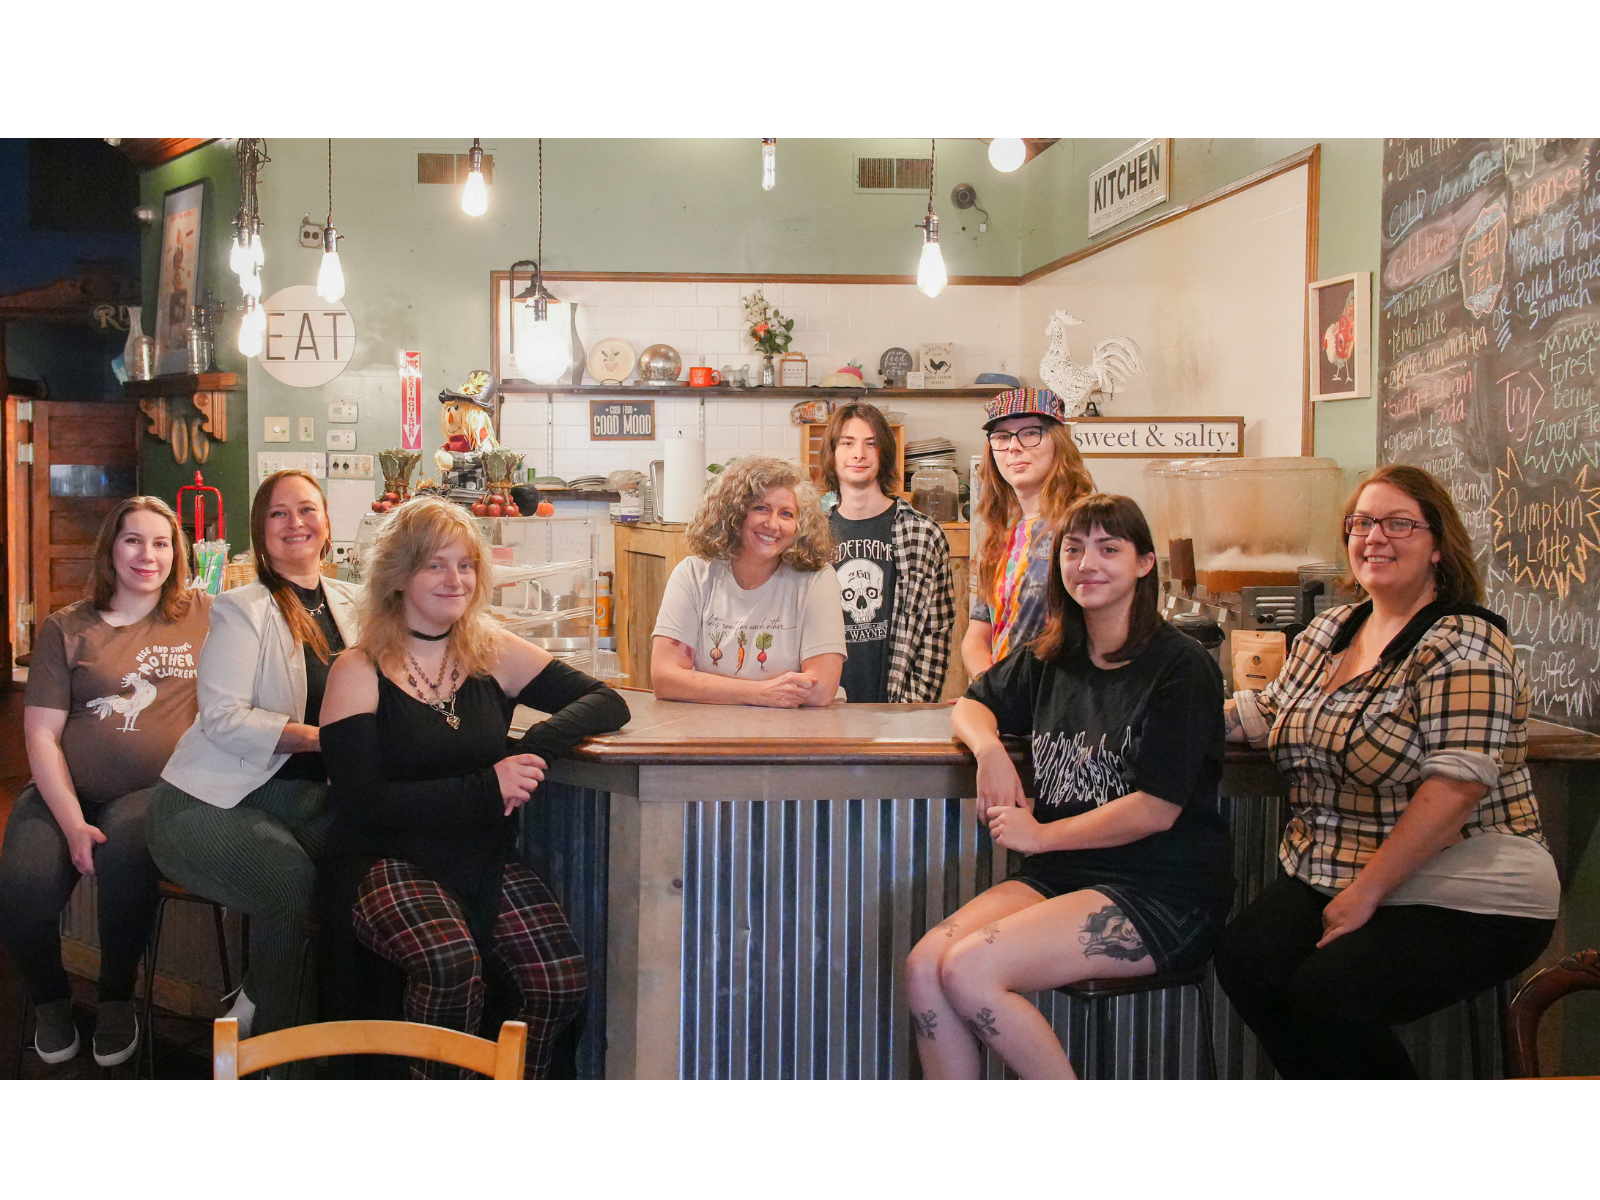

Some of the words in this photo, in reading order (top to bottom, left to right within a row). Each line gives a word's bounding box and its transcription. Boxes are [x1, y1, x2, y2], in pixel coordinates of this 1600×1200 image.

[1094, 142, 1161, 214] KITCHEN
[1389, 189, 1427, 238] COLD
[1467, 220, 1499, 267] SWEET
[1569, 217, 1600, 256] Pork
[1469, 262, 1493, 295] TEA
[1513, 268, 1553, 310] Pulled
[266, 312, 347, 360] EAT
[1549, 342, 1598, 383] Forest
[609, 405, 621, 415] GOOD
[622, 405, 633, 414] FOOD
[1496, 370, 1531, 442] Try
[1549, 382, 1593, 418] Berry
[593, 414, 619, 436] GOOD
[623, 414, 652, 435] MOOD
[1073, 428, 1139, 447] sweet
[1145, 424, 1166, 447] &
[1174, 423, 1236, 452] salty.
[1388, 427, 1423, 464] green
[1427, 413, 1453, 449] tea
[1535, 413, 1581, 457] Zinger
[1506, 486, 1583, 540] Pumpkin
[1527, 528, 1570, 568] Latte
[847, 569, 872, 584] 260
[1495, 589, 1543, 642] BOO
[135, 646, 152, 663] RISE
[152, 645, 169, 654] AND
[170, 642, 192, 654] SHINE
[137, 653, 195, 676] MOTHER
[1529, 641, 1580, 691] Coffee
